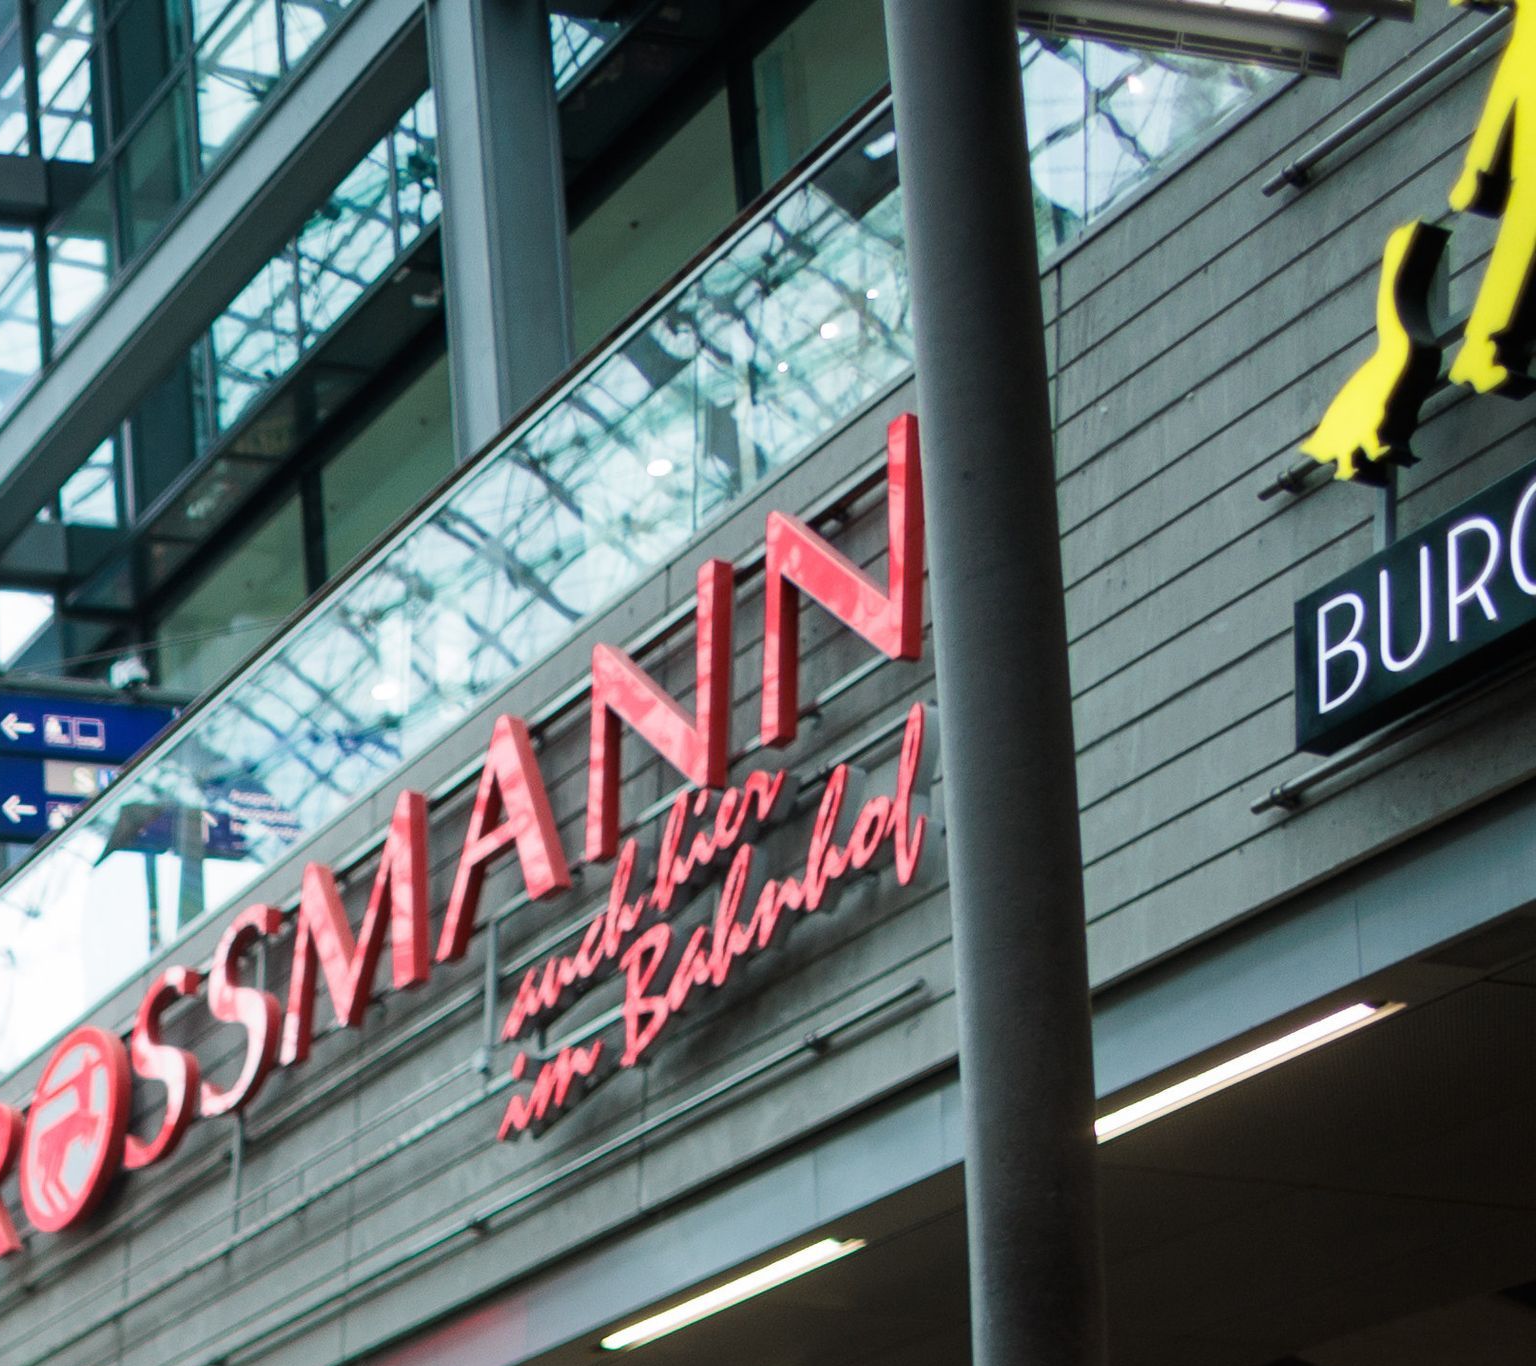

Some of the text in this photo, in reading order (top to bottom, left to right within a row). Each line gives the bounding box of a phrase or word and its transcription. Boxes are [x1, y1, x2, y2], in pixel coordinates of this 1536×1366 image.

[496, 702, 926, 1142] im Bahnhof
[650, 769, 786, 911] hier
